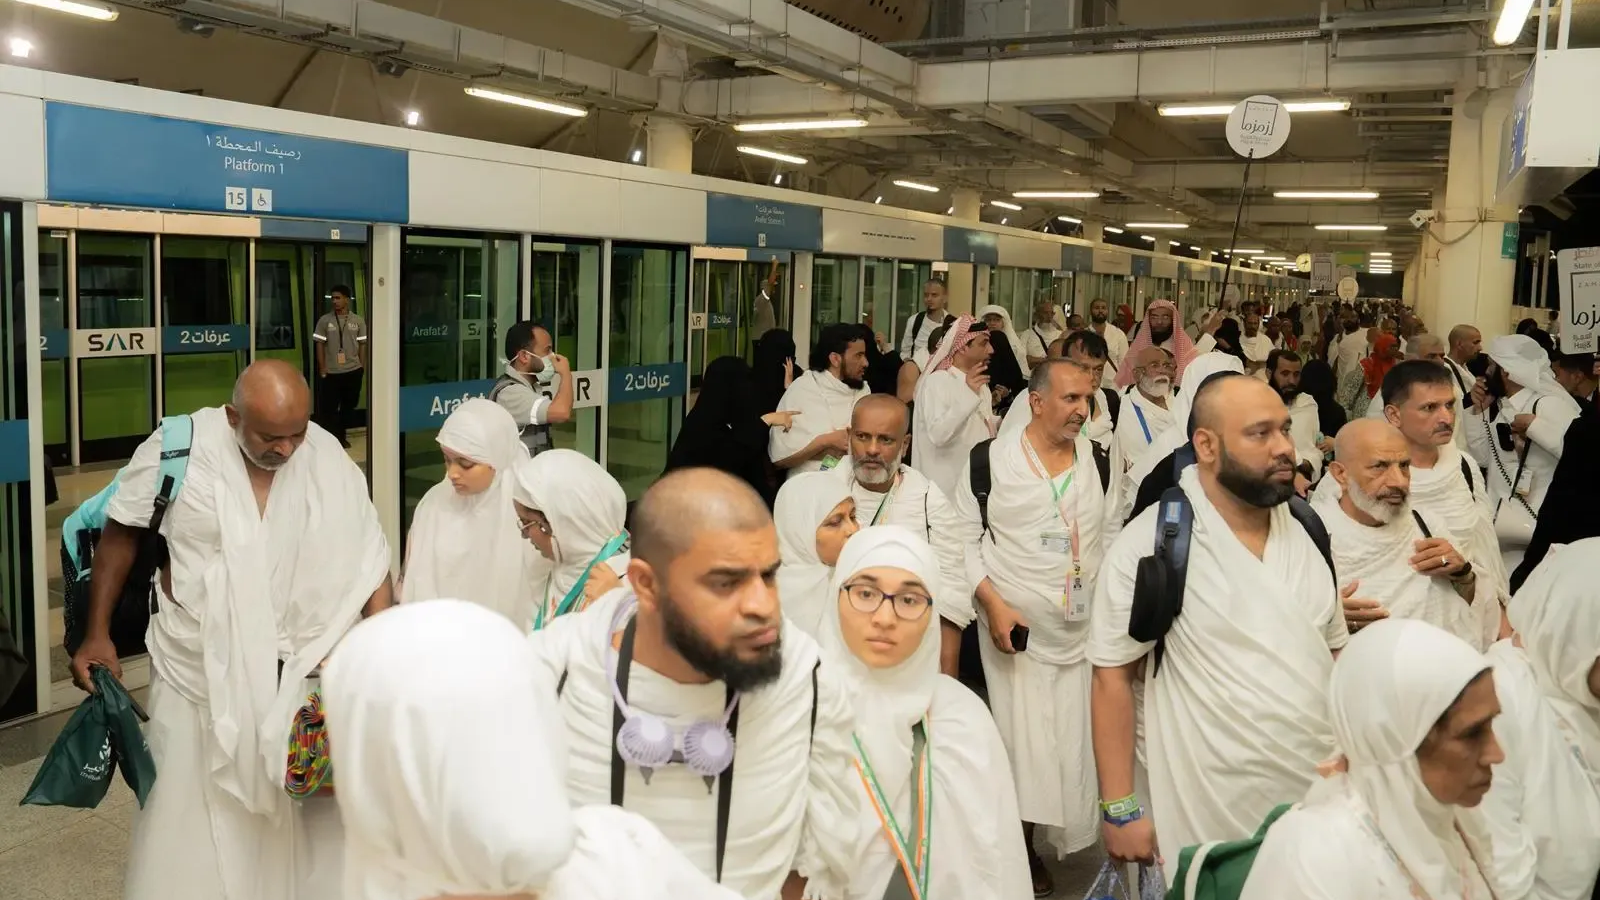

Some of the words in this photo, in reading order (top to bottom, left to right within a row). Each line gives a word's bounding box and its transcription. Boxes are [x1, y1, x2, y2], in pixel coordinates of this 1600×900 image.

[216, 135, 262, 152] المحطة
[264, 143, 302, 161] رصيف
[224, 155, 276, 174] Platform
[279, 163, 284, 175] 1
[228, 191, 245, 206] 15
[87, 332, 145, 352] SAR
